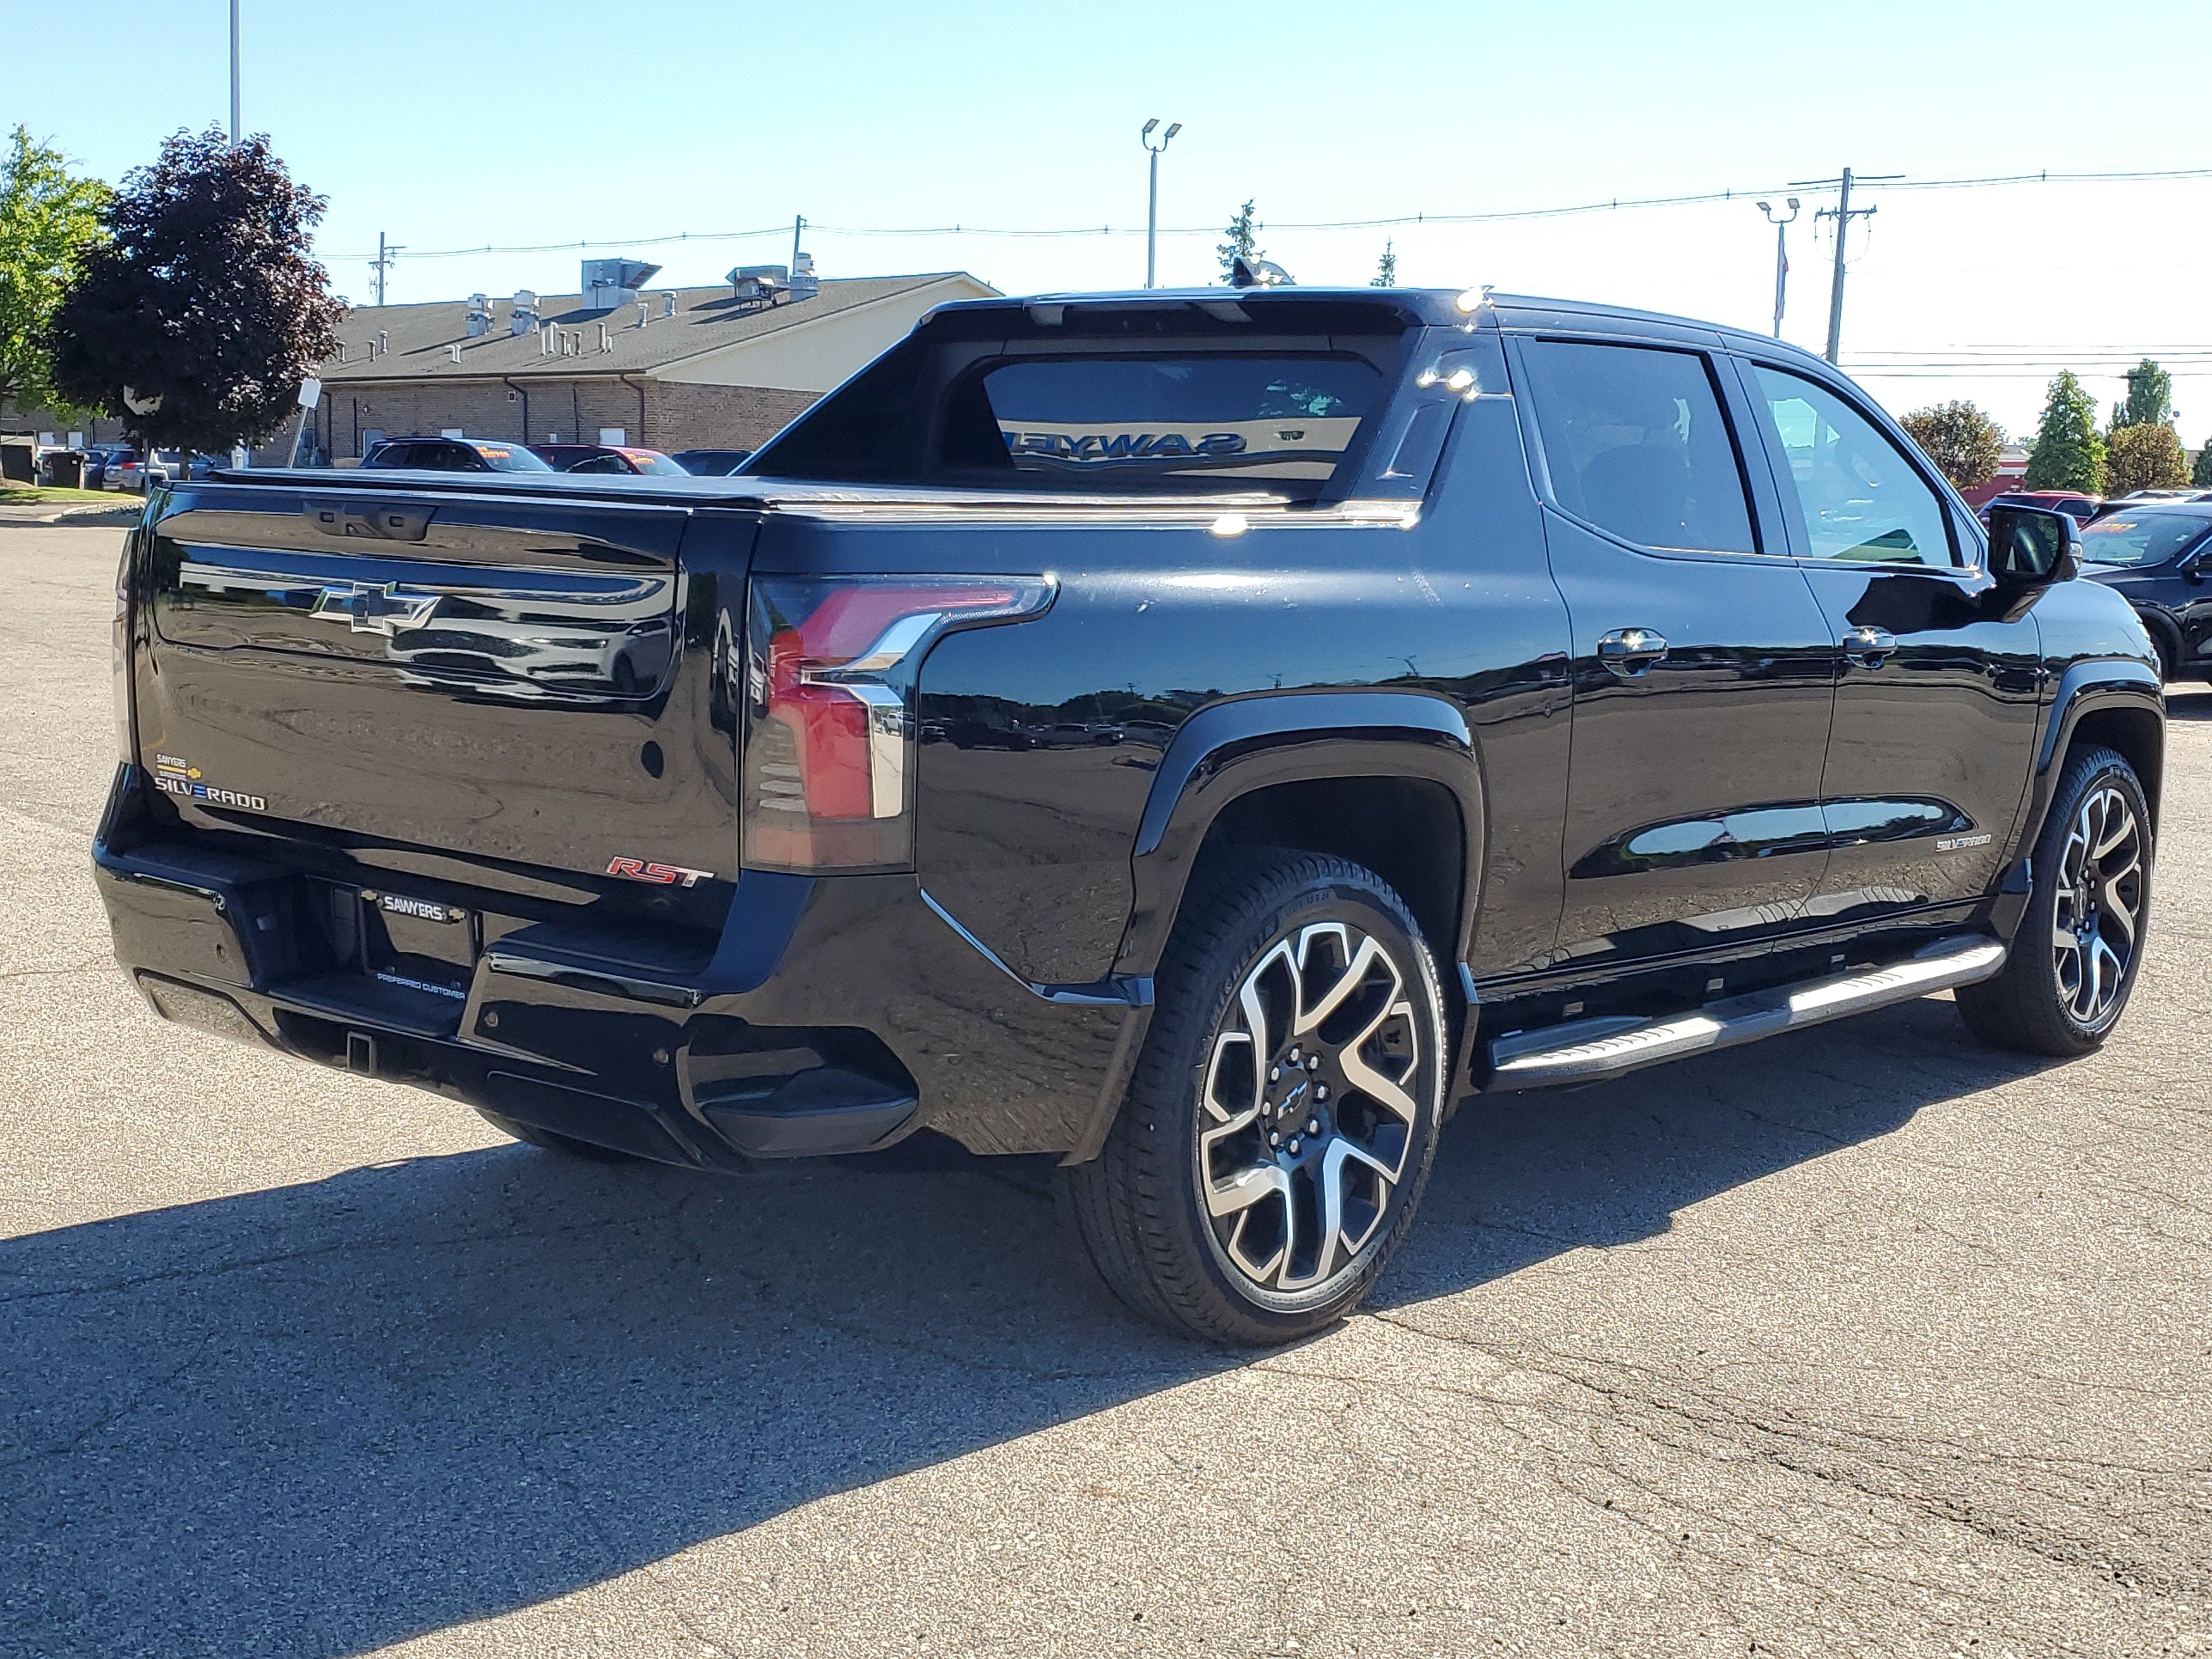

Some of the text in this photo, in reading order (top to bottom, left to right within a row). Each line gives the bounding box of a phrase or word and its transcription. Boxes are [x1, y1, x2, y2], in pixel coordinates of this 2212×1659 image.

[155, 777, 267, 810] SILVERADO
[1935, 834, 1992, 853] SILVERADO
[606, 856, 715, 888] RST
[384, 896, 443, 921] SAWYERS
[377, 973, 465, 1000] PREFERRED CUSTOMER
